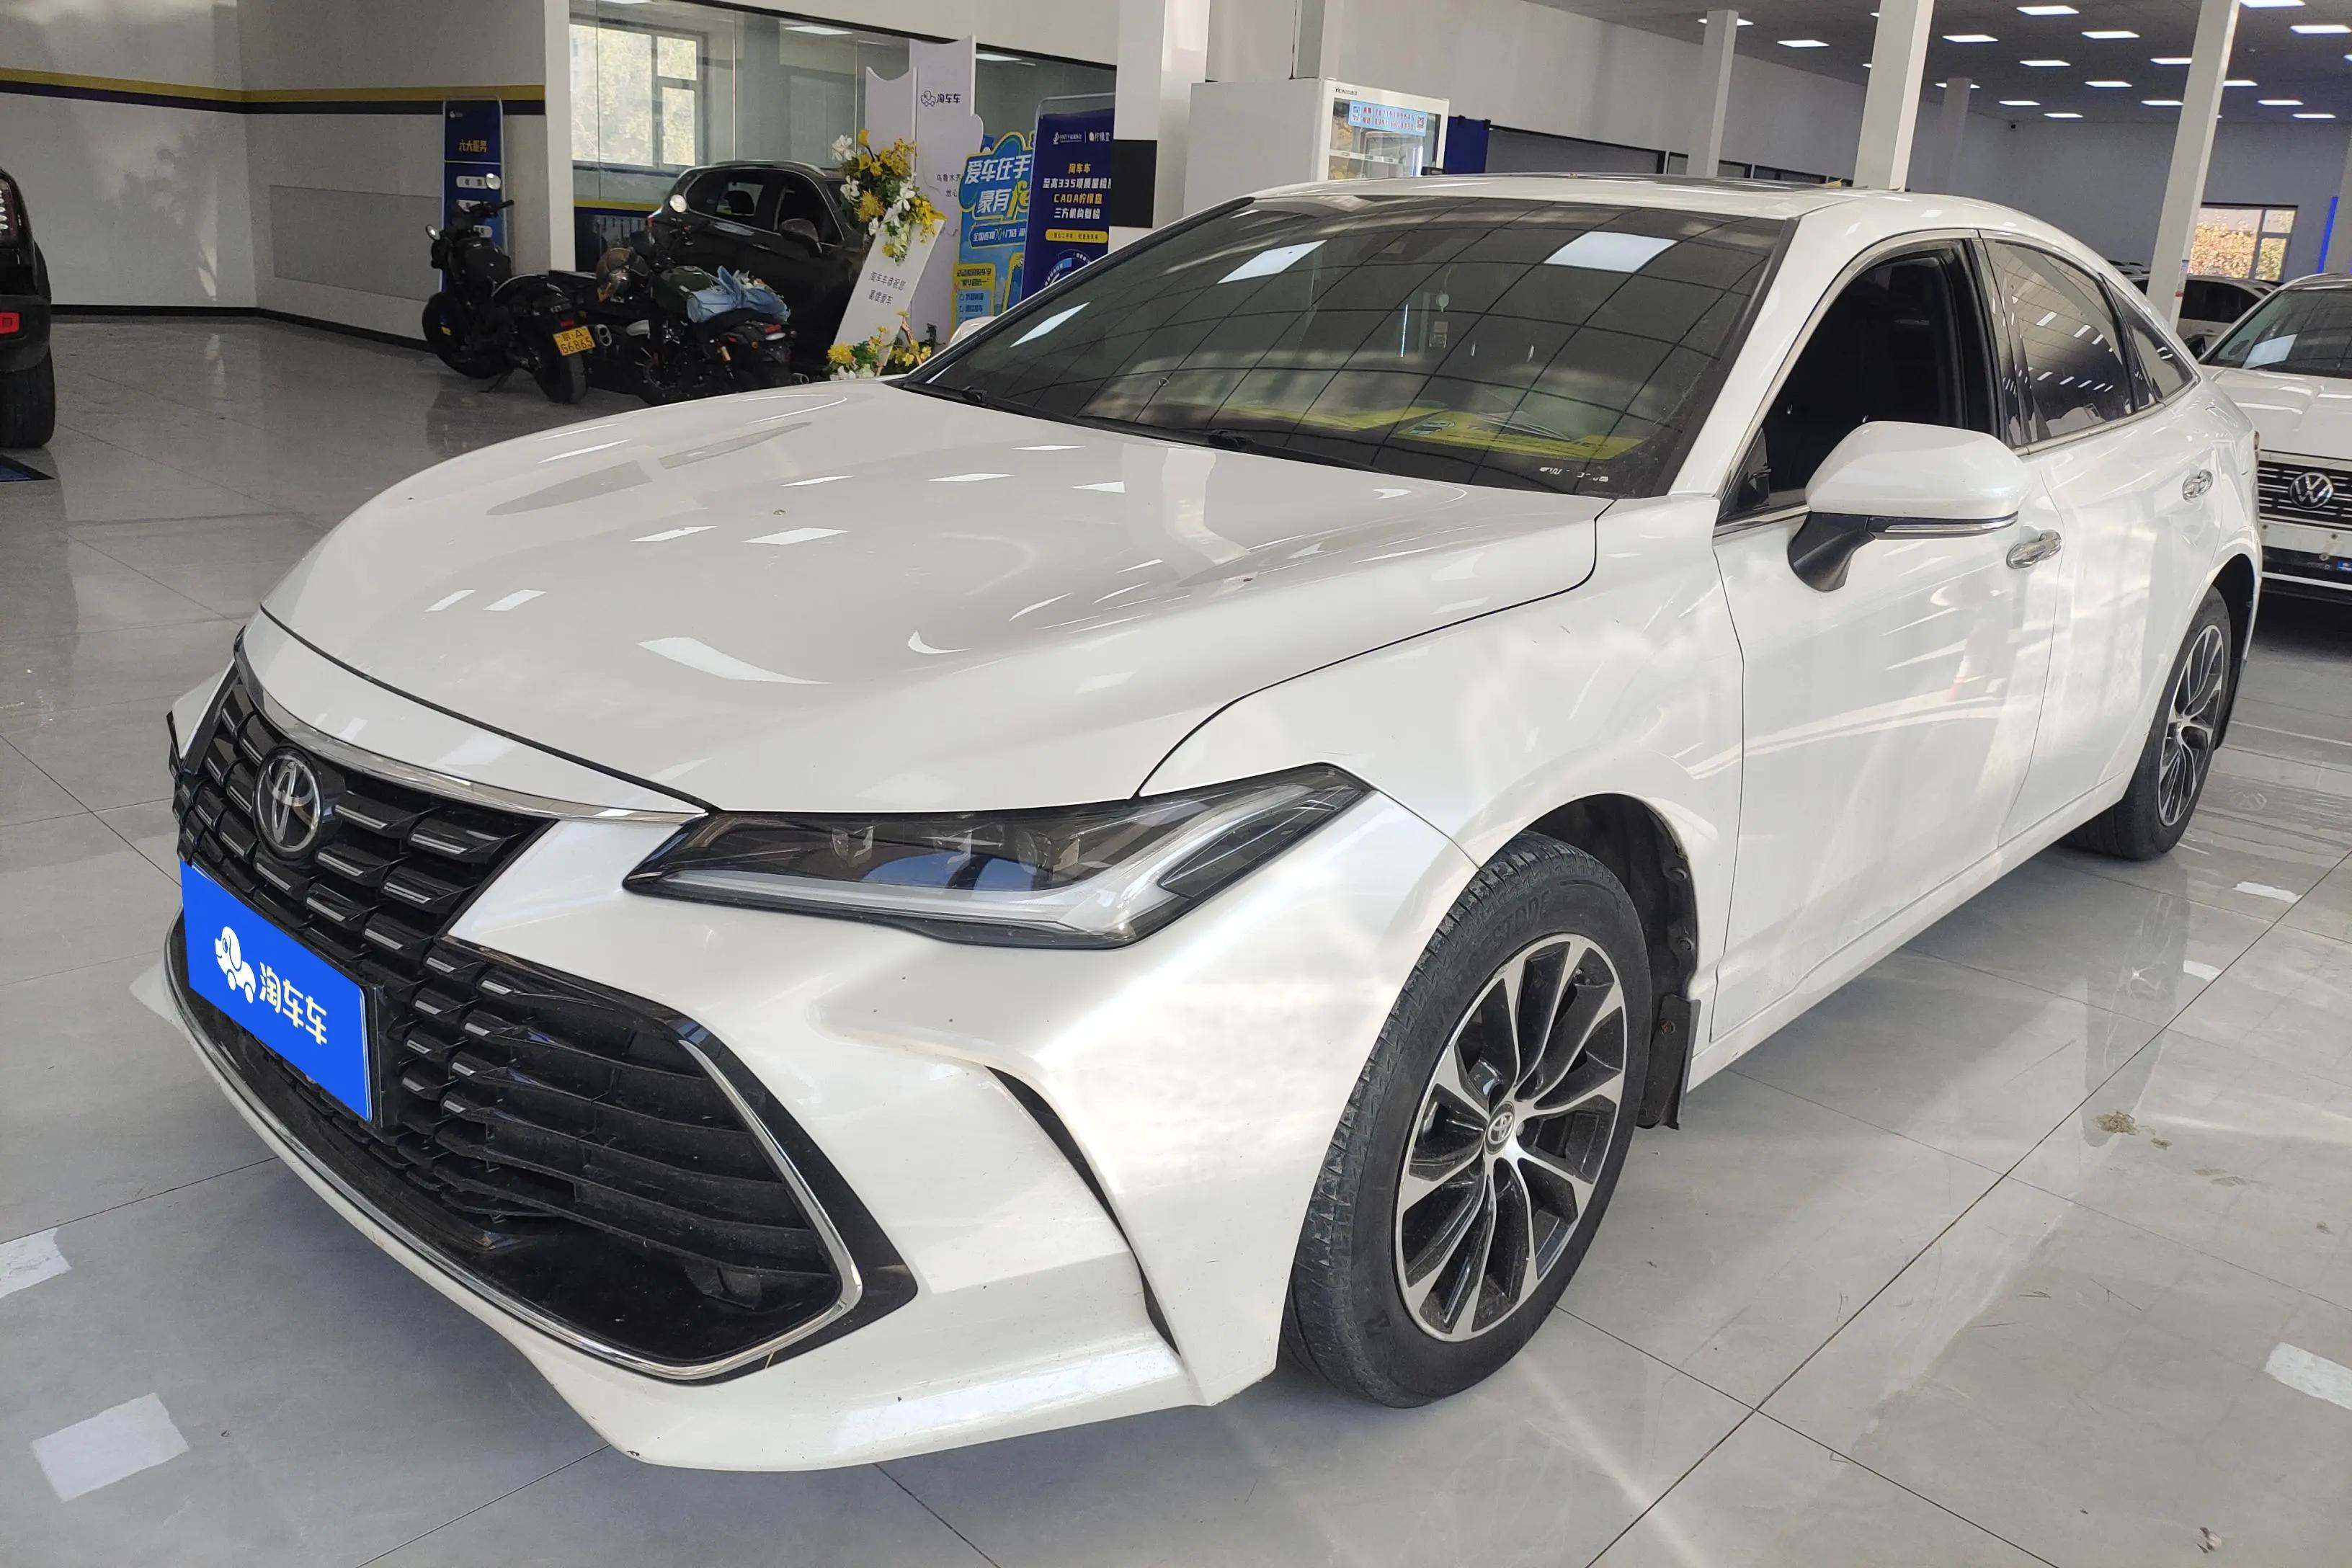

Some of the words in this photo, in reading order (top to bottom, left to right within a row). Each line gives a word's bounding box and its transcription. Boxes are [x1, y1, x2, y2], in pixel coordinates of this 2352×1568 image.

[937, 94, 961, 103] 淘车车
[459, 139, 488, 153] 六大服务
[964, 154, 1032, 184] 爱车在手
[1068, 163, 1091, 174] 淘车车
[1054, 193, 1102, 204] CADA柠檬查
[1054, 208, 1100, 219] 三方机构复检
